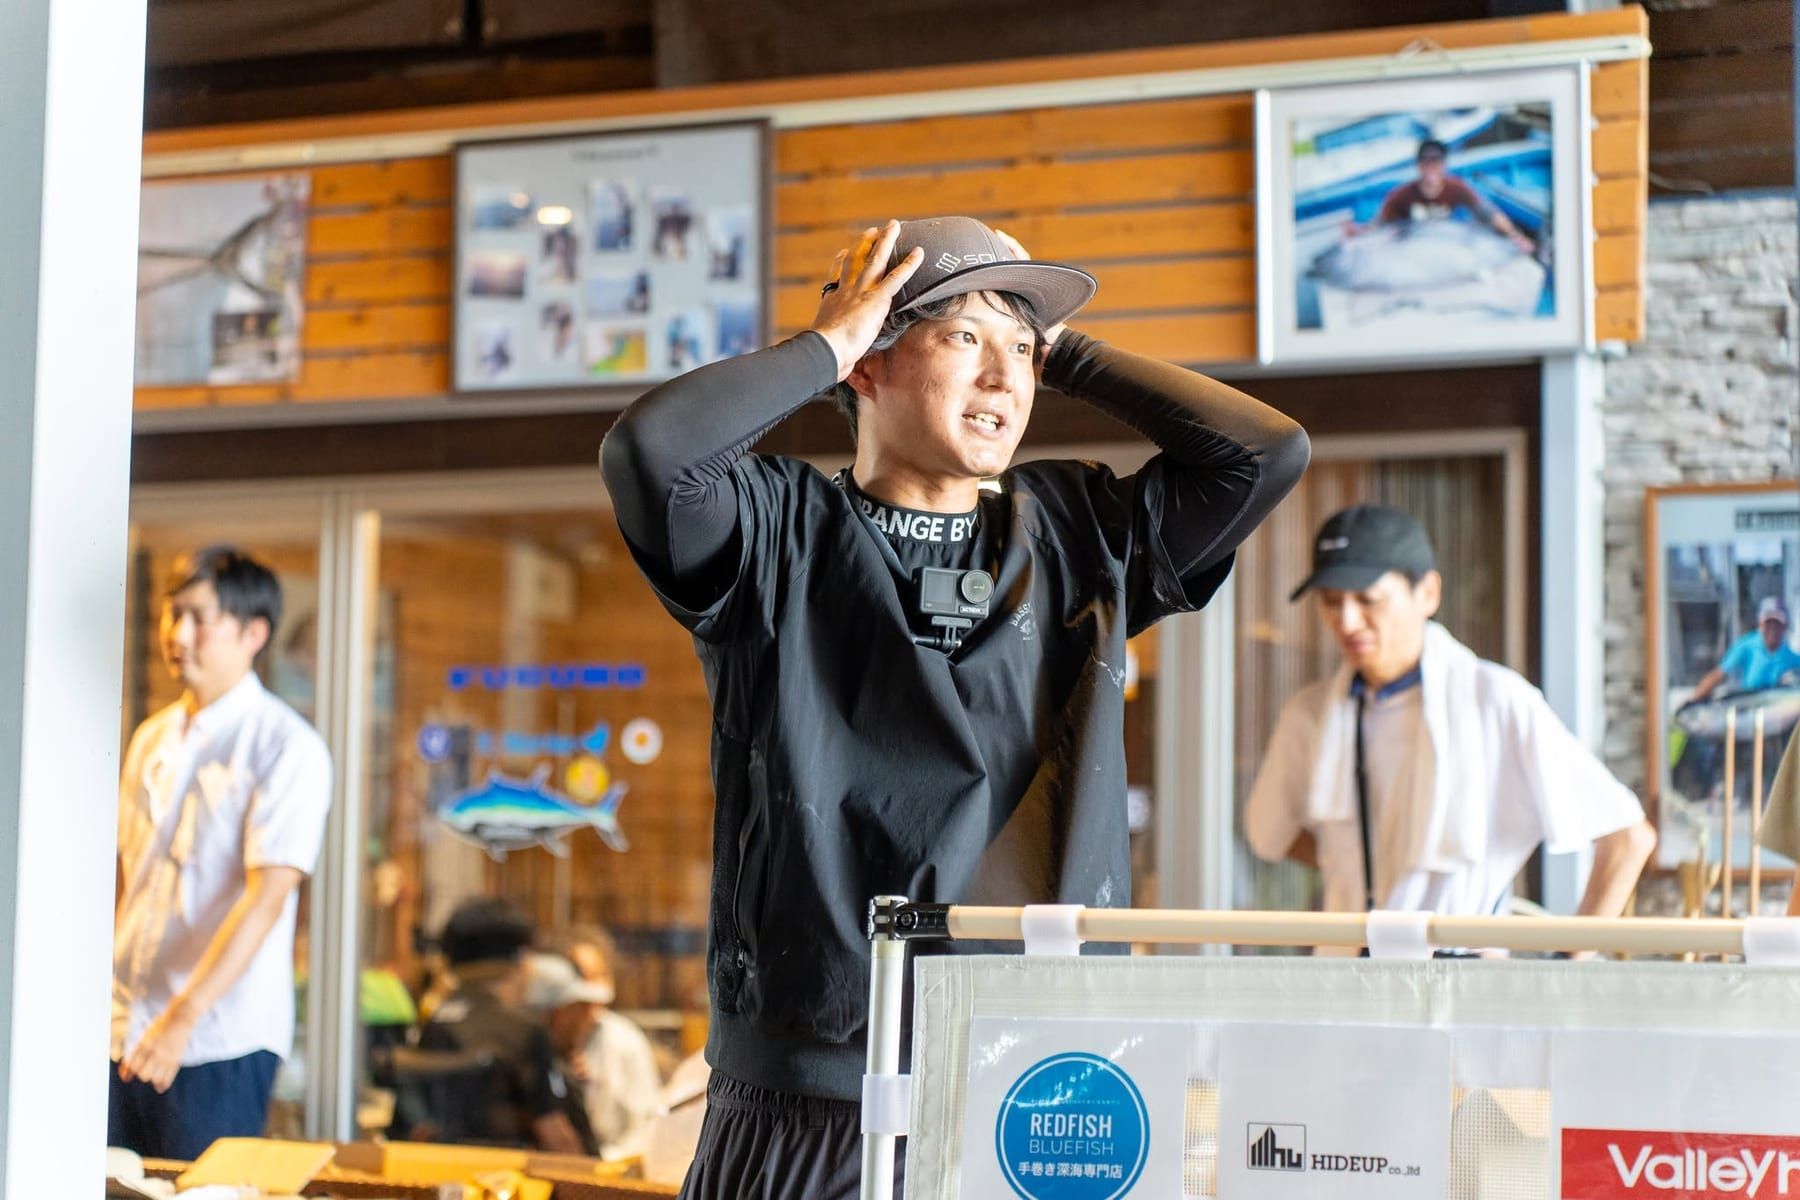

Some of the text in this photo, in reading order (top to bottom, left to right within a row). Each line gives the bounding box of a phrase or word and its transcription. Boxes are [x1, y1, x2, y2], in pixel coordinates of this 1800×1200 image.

[951, 514, 978, 542] BY
[1030, 1112, 1112, 1138] REDFISH
[1028, 1139, 1114, 1156] BLUEFISH
[1018, 1161, 1123, 1179] 手巻き深海専門店
[1311, 1154, 1388, 1173] HIDEUP
